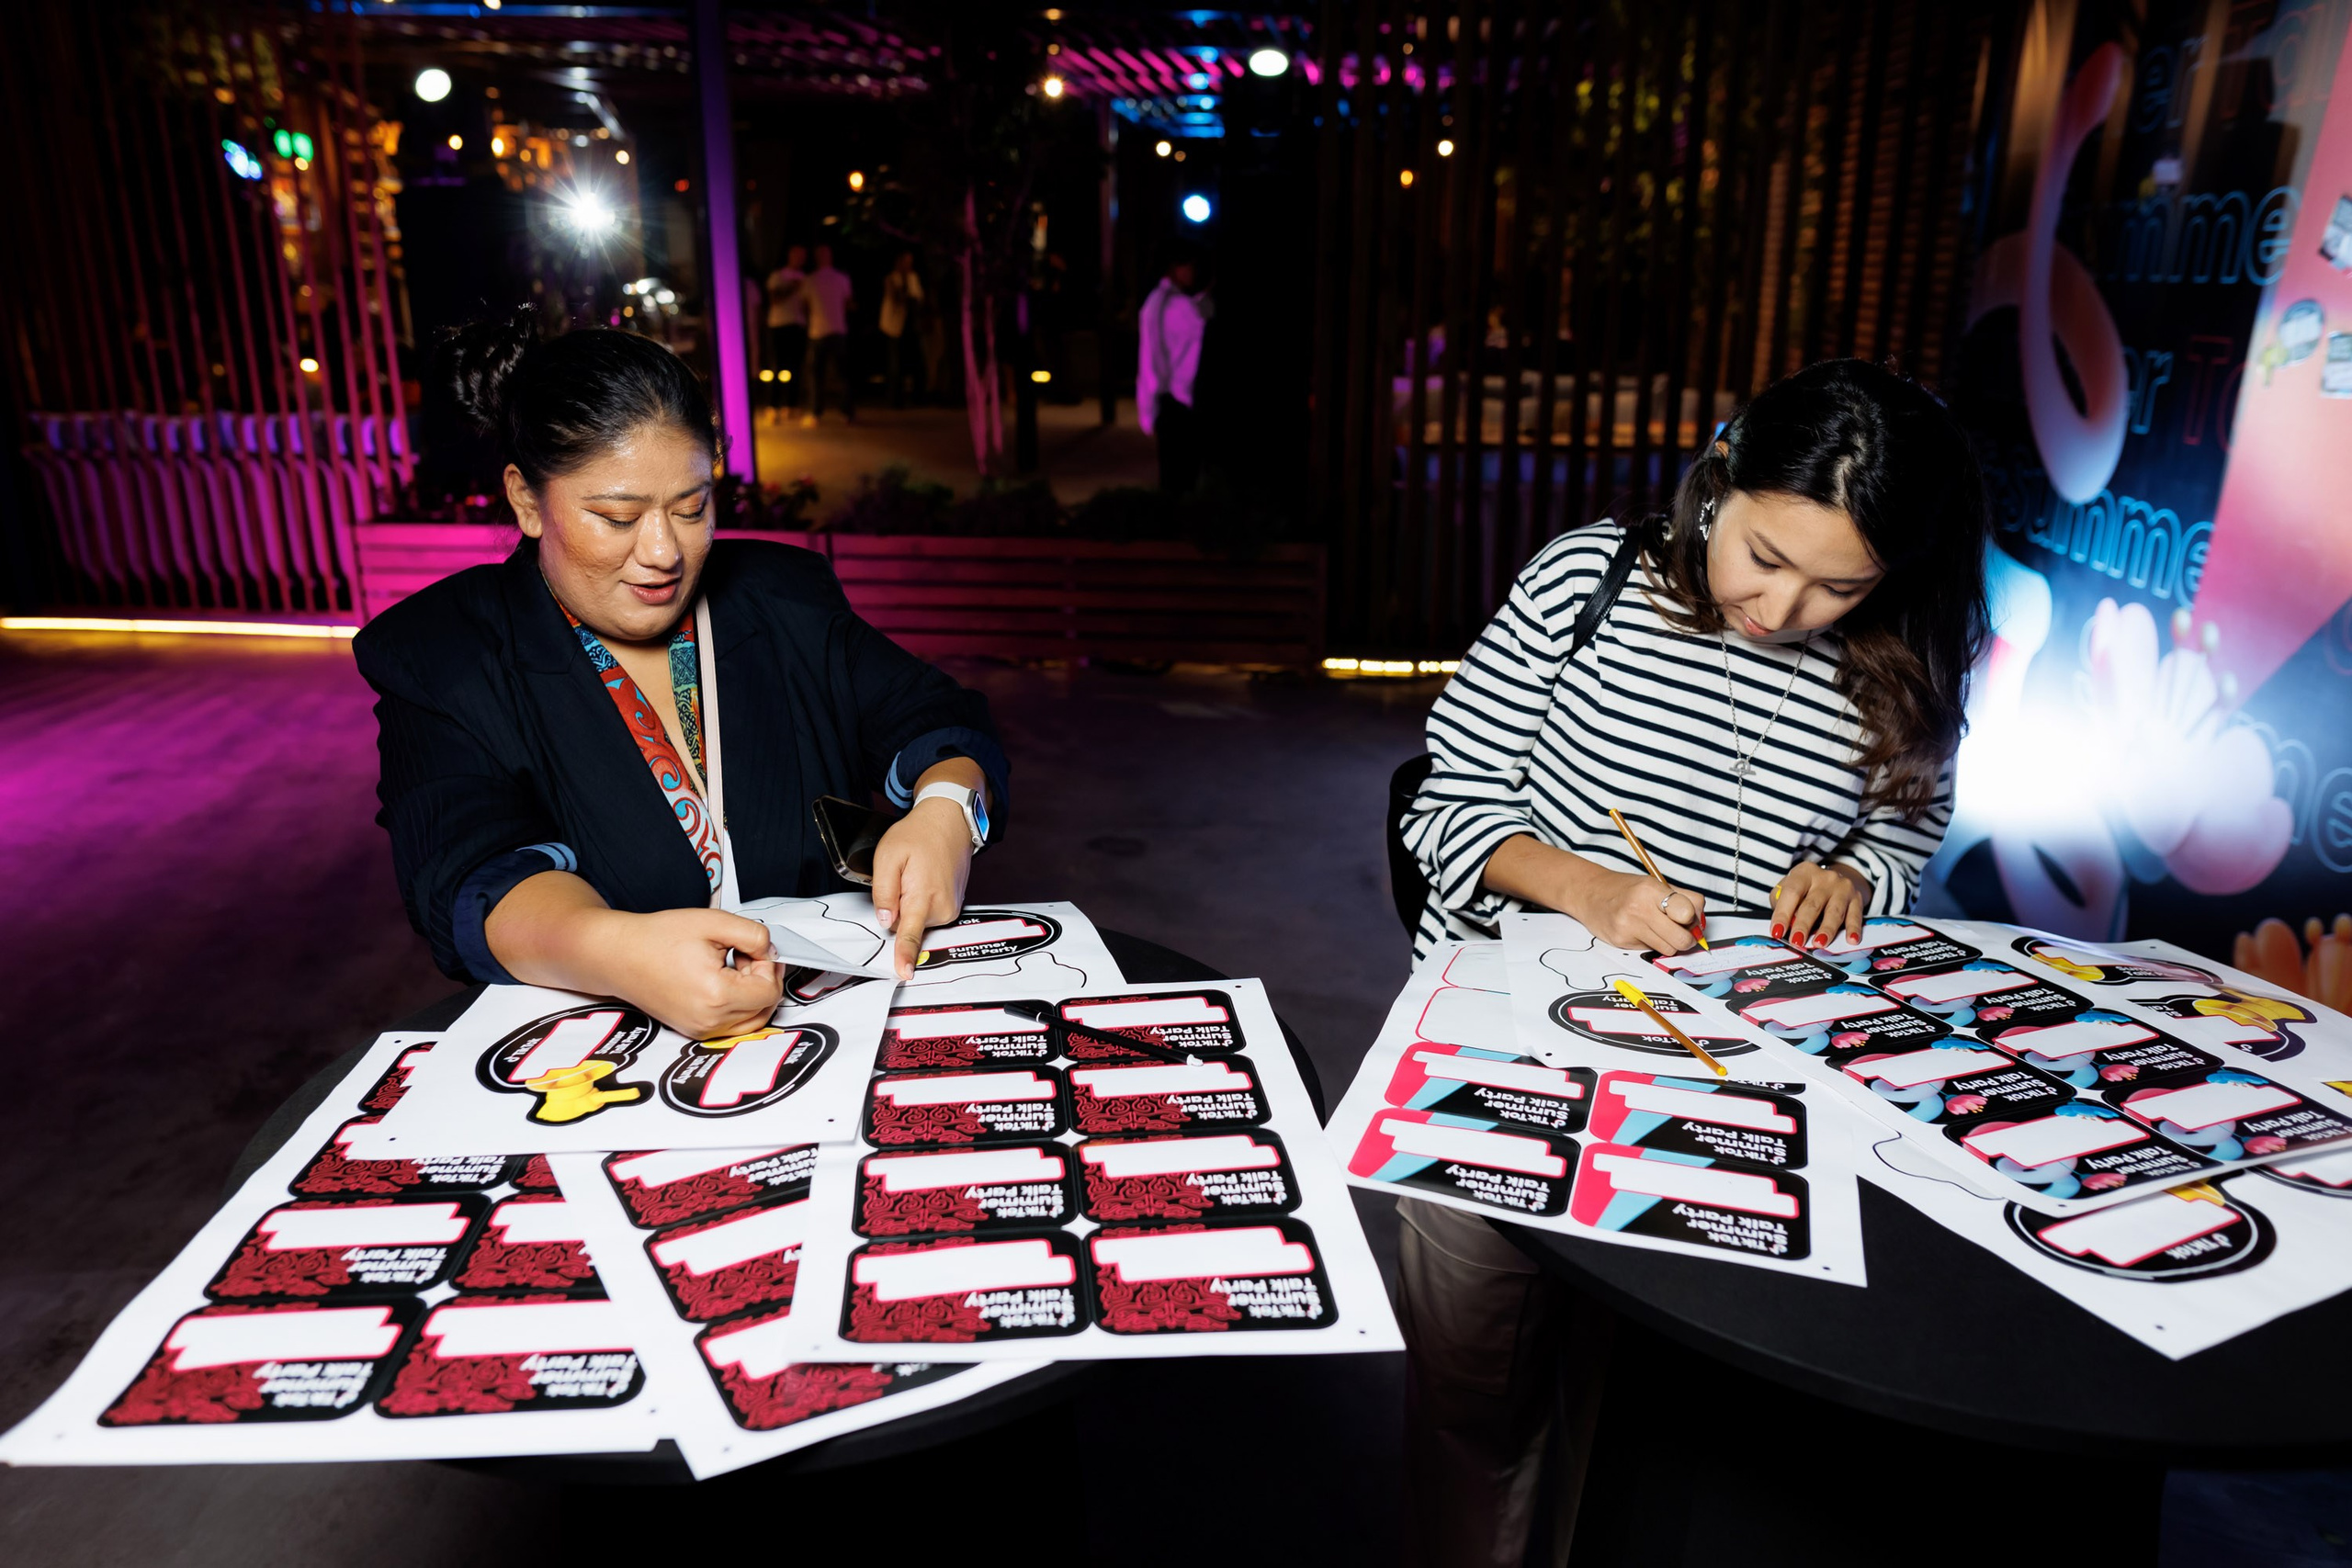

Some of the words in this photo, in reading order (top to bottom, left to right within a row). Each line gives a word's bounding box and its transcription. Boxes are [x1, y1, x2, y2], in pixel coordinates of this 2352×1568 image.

[948, 942, 1006, 953] Summer
[981, 945, 1017, 954] Party
[1901, 944, 1958, 959] Summer
[1916, 941, 1948, 949] Talk
[1745, 966, 1784, 976] Party
[1781, 962, 1815, 971] Talk
[1765, 967, 1825, 980] Summer
[1784, 974, 1823, 984] TikTok
[1983, 993, 2025, 1004] Party
[2019, 987, 2054, 998] Talk
[2007, 994, 2066, 1008] Summer
[1840, 1018, 1883, 1029] Party
[1879, 1013, 1916, 1022] Talk
[1149, 1027, 1193, 1035] Party
[1195, 1025, 1230, 1033] Talk
[1863, 1019, 1927, 1033] Summer
[1884, 1026, 1927, 1038] TikTok
[965, 1036, 1009, 1044] Party
[1012, 1034, 1047, 1043] Talk
[1162, 1032, 1232, 1042] Summer
[1641, 1035, 1681, 1044] kTok
[977, 1043, 1047, 1051] Summer
[2142, 1043, 2179, 1055] Talk
[2102, 1050, 2148, 1061] Party
[2129, 1051, 2193, 1066] Summer
[1952, 1077, 2000, 1090] Party
[1994, 1071, 2034, 1083] Talk
[1978, 1078, 2047, 1097] Summer
[1167, 1095, 1214, 1104] Party
[1216, 1093, 1254, 1102] Talk
[1474, 1087, 1526, 1104] Party
[2002, 1089, 2048, 1101] TikTok
[965, 1103, 1012, 1113] Party
[1016, 1103, 1054, 1112] Talk
[1181, 1101, 1256, 1112] Summer
[1484, 1100, 1568, 1120] Summer
[1529, 1097, 1570, 1111] Talk
[977, 1112, 1055, 1122] Summer
[1197, 1110, 1244, 1120] TikTok
[1499, 1110, 1549, 1125] TikTok
[2284, 1110, 2326, 1123] Talk
[993, 1122, 1041, 1132] TikTok
[1681, 1122, 1737, 1140] Party
[2243, 1117, 2293, 1133] Party
[1694, 1134, 1787, 1156] Summer
[1741, 1133, 1787, 1148] Talk
[1713, 1145, 1770, 1162] TikTok
[2128, 1145, 2173, 1159] Talk
[465, 1156, 506, 1165] Talk
[2085, 1153, 2137, 1169] Party
[416, 1165, 503, 1174] Summer
[1445, 1164, 1502, 1184] Party
[1186, 1173, 1238, 1186] Party
[1240, 1170, 1283, 1183] Talk
[1021, 1184, 1063, 1196] Talk
[1202, 1181, 1285, 1196] Summer
[1455, 1179, 1548, 1202] Summer
[1505, 1175, 1550, 1193] Talk
[965, 1185, 1018, 1199] Party
[978, 1195, 1064, 1209] Summer
[1473, 1190, 1527, 1208] TikTok
[1672, 1203, 1734, 1225] Party
[1737, 1214, 1788, 1235] Talk
[1686, 1218, 1788, 1245] Summer
[1706, 1230, 1769, 1252] TikTok
[1210, 1277, 1268, 1294] Party
[1269, 1277, 1317, 1292] Talk
